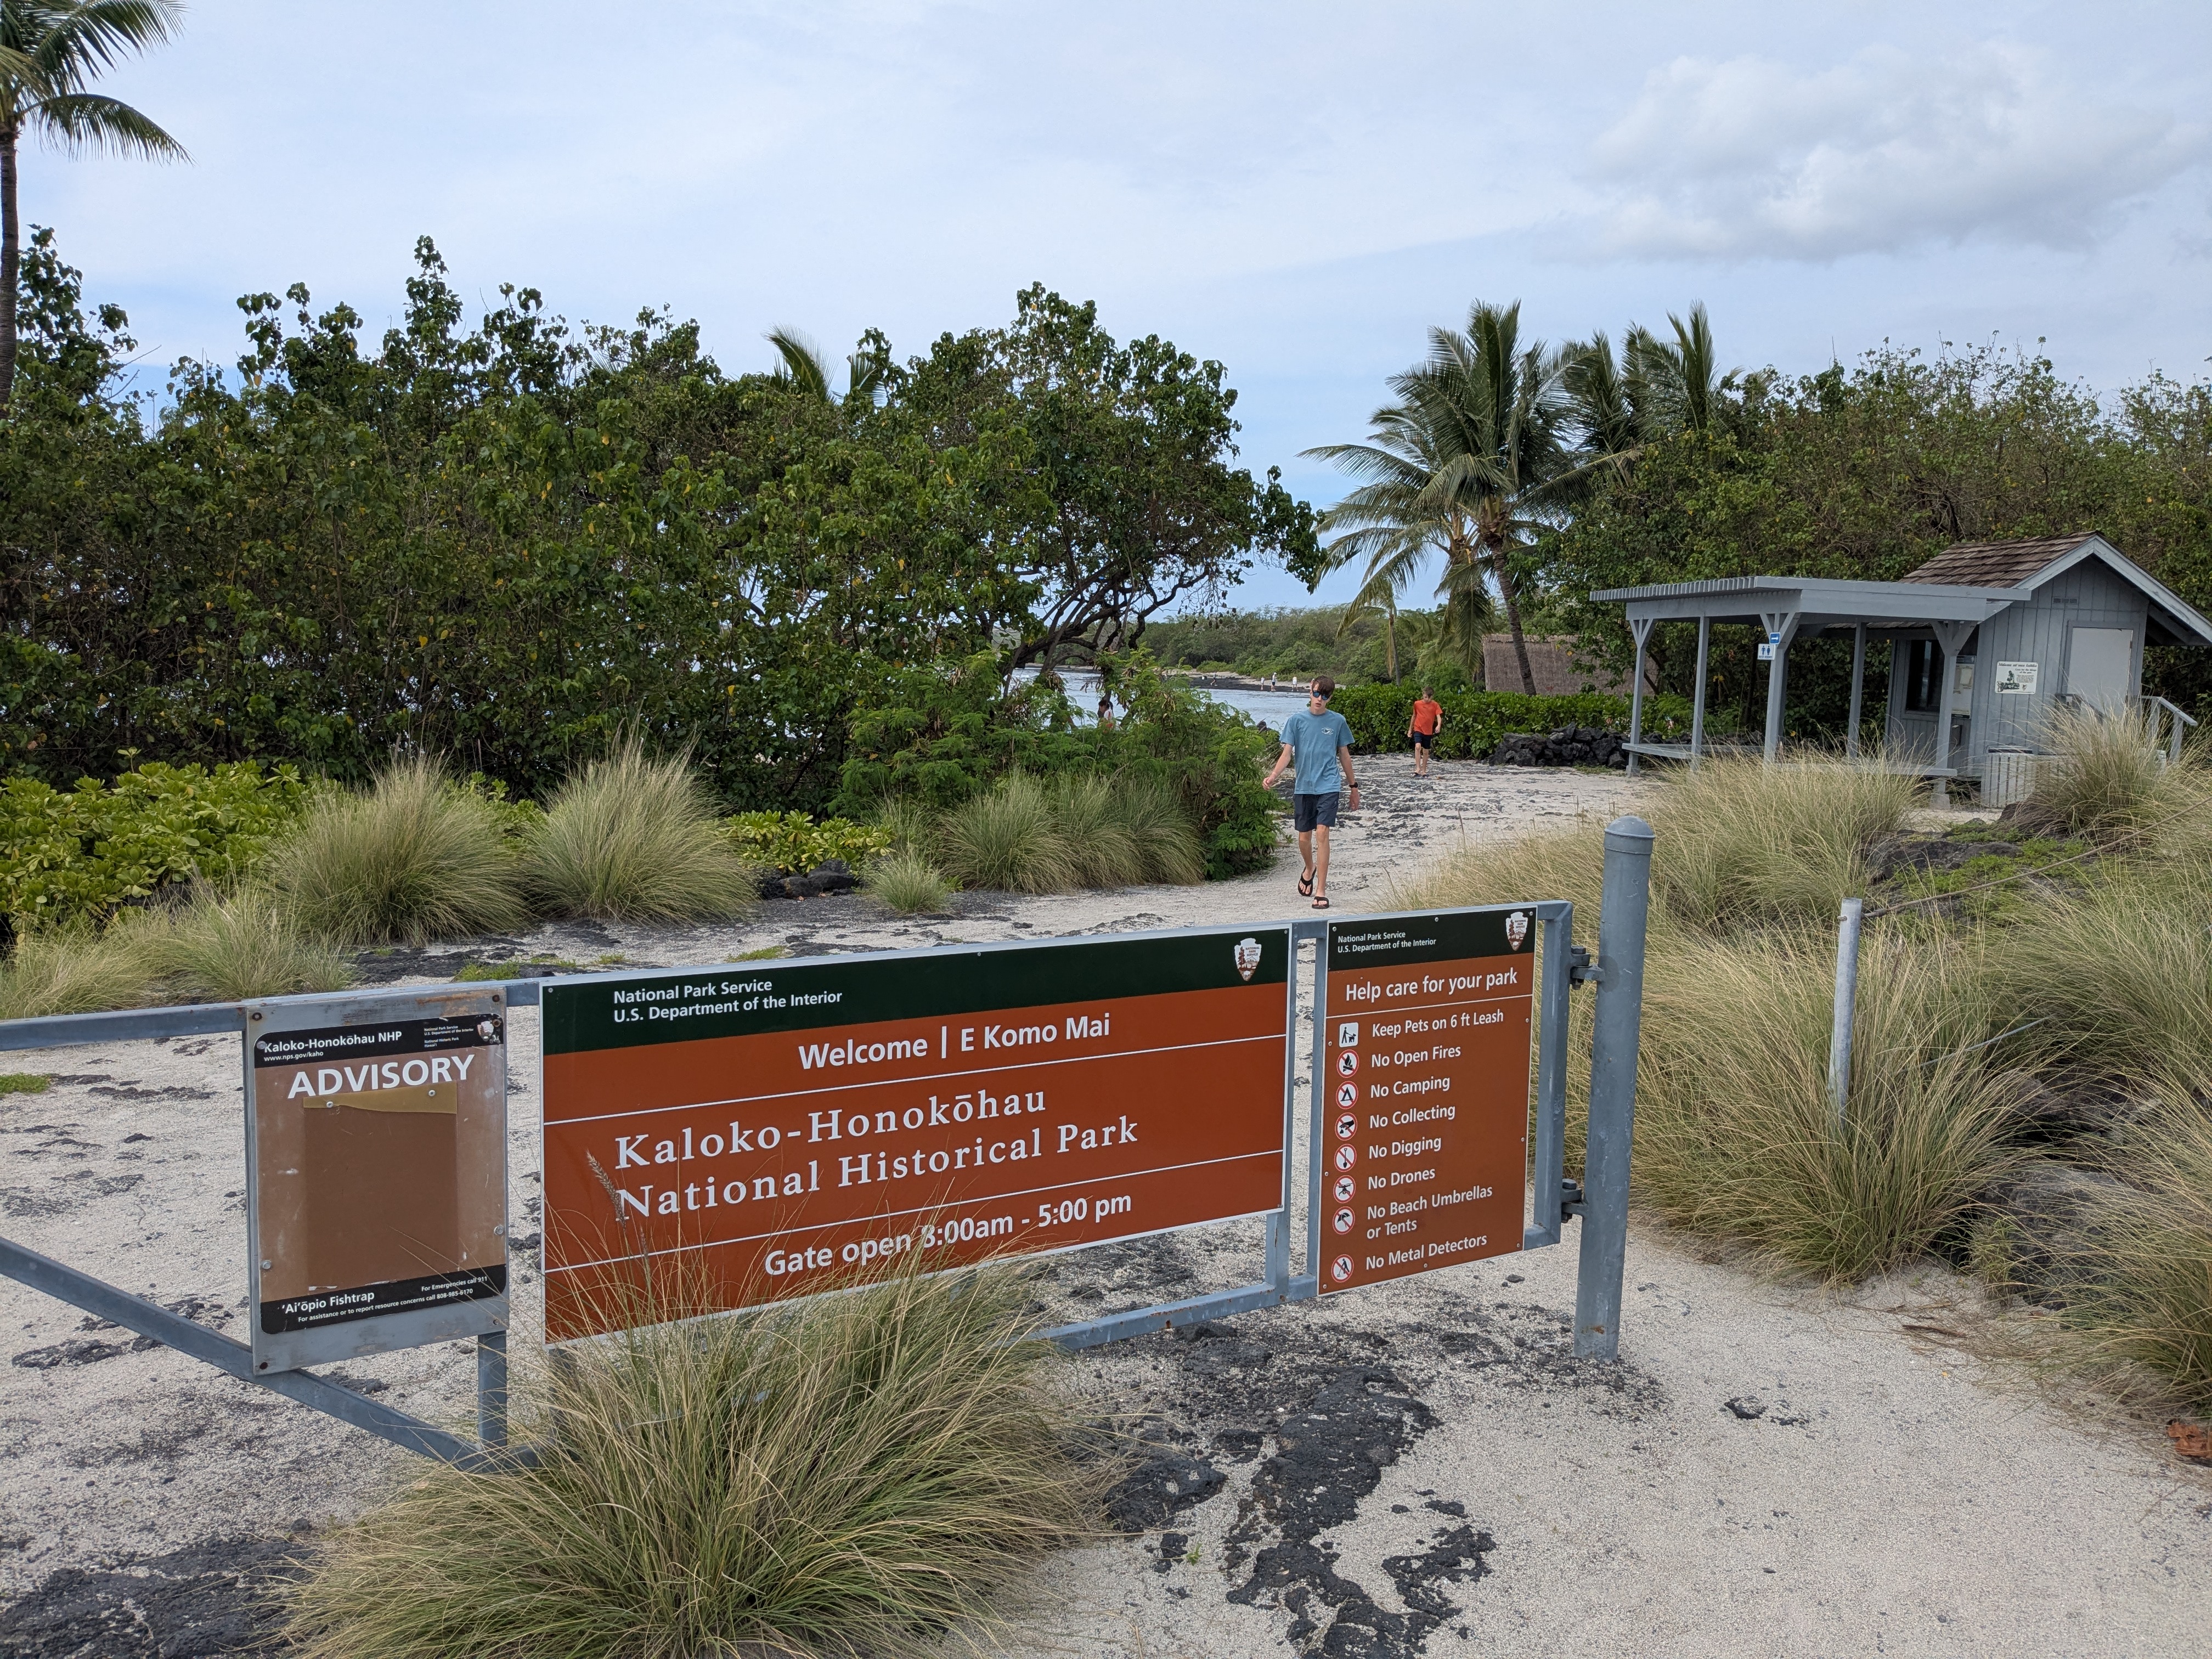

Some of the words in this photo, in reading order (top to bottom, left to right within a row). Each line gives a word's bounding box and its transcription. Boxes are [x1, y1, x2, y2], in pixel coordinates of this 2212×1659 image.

[1338, 934, 1365, 943] National
[1353, 943, 1391, 952] Department
[1413, 938, 1436, 946] Interior
[614, 986, 679, 1003] National
[685, 983, 716, 997] Park
[721, 979, 772, 994] Service
[1347, 981, 1380, 1002] Help
[1386, 982, 1418, 996] care
[1423, 975, 1444, 992] for
[1449, 975, 1482, 995] your
[1487, 967, 1517, 990] park
[614, 1008, 643, 1022] U.S.
[650, 1000, 739, 1020] Department
[743, 997, 759, 1010] of
[763, 996, 786, 1008] the
[791, 991, 842, 1006] Interior
[1373, 1024, 1401, 1038] Keep
[1406, 1019, 1428, 1033] Pets
[1432, 1019, 1446, 1030] on
[1451, 1015, 1457, 1028] 6
[1461, 1013, 1470, 1026] ft
[1474, 1009, 1503, 1025] Leash
[378, 1031, 402, 1042] NHP
[799, 1039, 927, 1069] Welcome
[962, 1028, 974, 1051] E
[985, 1025, 1057, 1048] Komo
[1066, 1013, 1109, 1039] Mai
[264, 1051, 324, 1062] www.nps.gov/kaho
[1372, 1054, 1390, 1067] No
[1395, 1051, 1427, 1066] Open
[1433, 1045, 1460, 1059] Fires
[287, 1054, 475, 1099] ADVISORY
[1371, 1084, 1389, 1098] No
[1393, 1076, 1449, 1094] Camping
[1370, 1115, 1387, 1128] No
[1393, 1105, 1455, 1125] Collecting
[614, 1090, 1046, 1169] Kaloko-Honokōhau
[1369, 1145, 1387, 1159] No
[1392, 1137, 1441, 1156] Digging
[615, 1160, 820, 1221] National
[838, 1128, 1041, 1188] Historical
[1057, 1116, 1138, 1153] Park
[1369, 1176, 1386, 1189] No
[1391, 1169, 1435, 1186] Drones
[1368, 1206, 1385, 1220] No
[1390, 1196, 1427, 1215] Beach
[1432, 1186, 1492, 1207] Umbrellas
[765, 1246, 832, 1276] Gate
[842, 1232, 911, 1265] open
[922, 1212, 1013, 1249] 8:00am
[1039, 1198, 1087, 1227] 5:00
[1095, 1194, 1132, 1222] pm
[1367, 1227, 1381, 1239] or
[1385, 1219, 1417, 1235] Tents
[1367, 1256, 1384, 1269] No
[1389, 1245, 1424, 1265] Metal
[1429, 1235, 1487, 1256] Detectors
[432, 1281, 466, 1290] Emergencies
[309, 1312, 338, 1321] assistance
[356, 1305, 374, 1313] report
[375, 1301, 399, 1310] resource
[437, 1289, 473, 1299] 808-985-6170
[330, 1292, 375, 1306] Fishtrap
